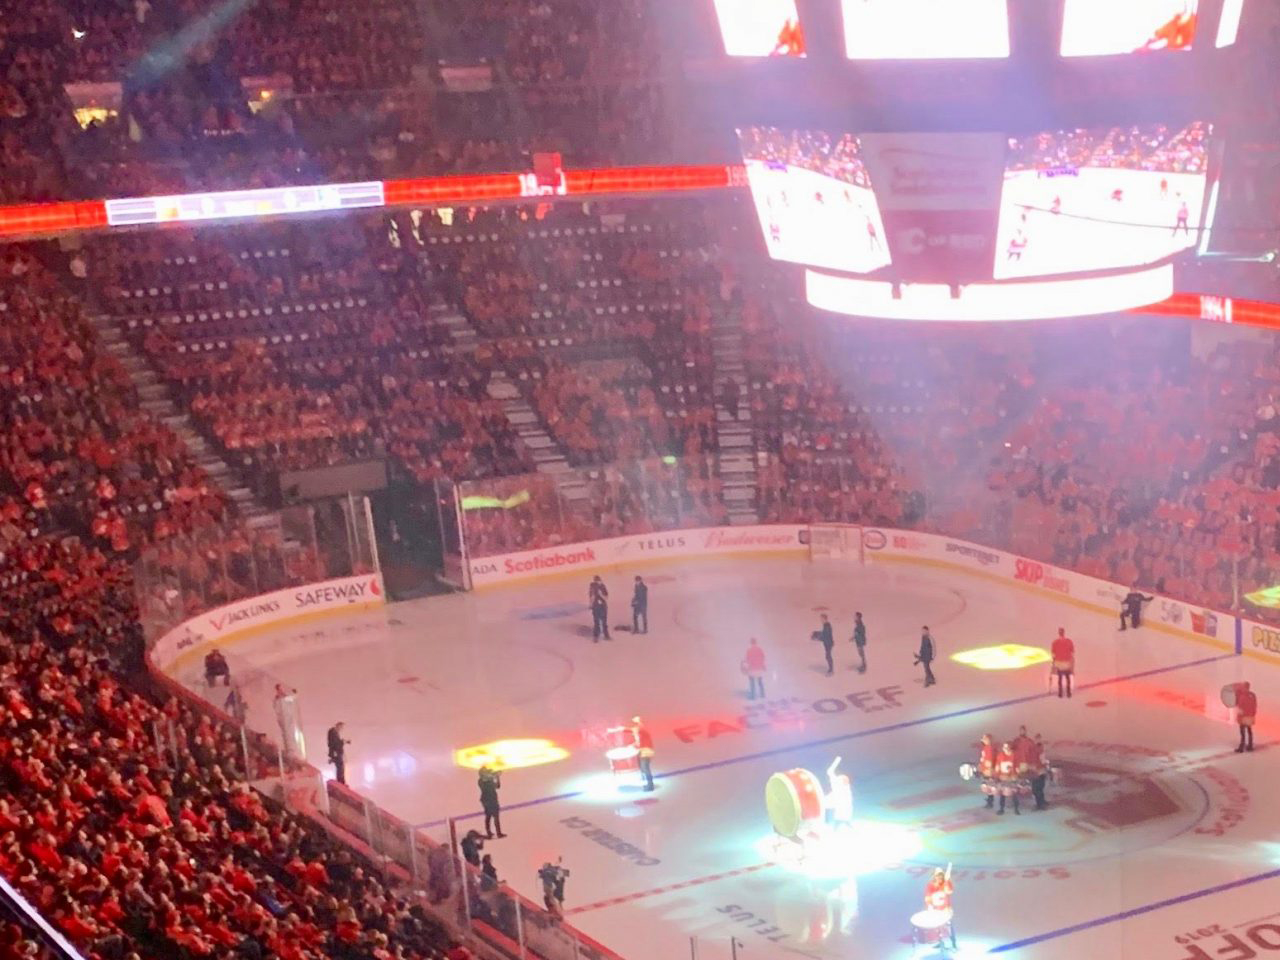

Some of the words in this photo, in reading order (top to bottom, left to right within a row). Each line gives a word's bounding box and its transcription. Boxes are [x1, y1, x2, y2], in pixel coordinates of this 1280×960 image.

[638, 537, 686, 550] TELUS
[504, 549, 597, 575] Scotiabank
[295, 582, 367, 608] SAFEWAY
[1174, 923, 1227, 945] 2019
